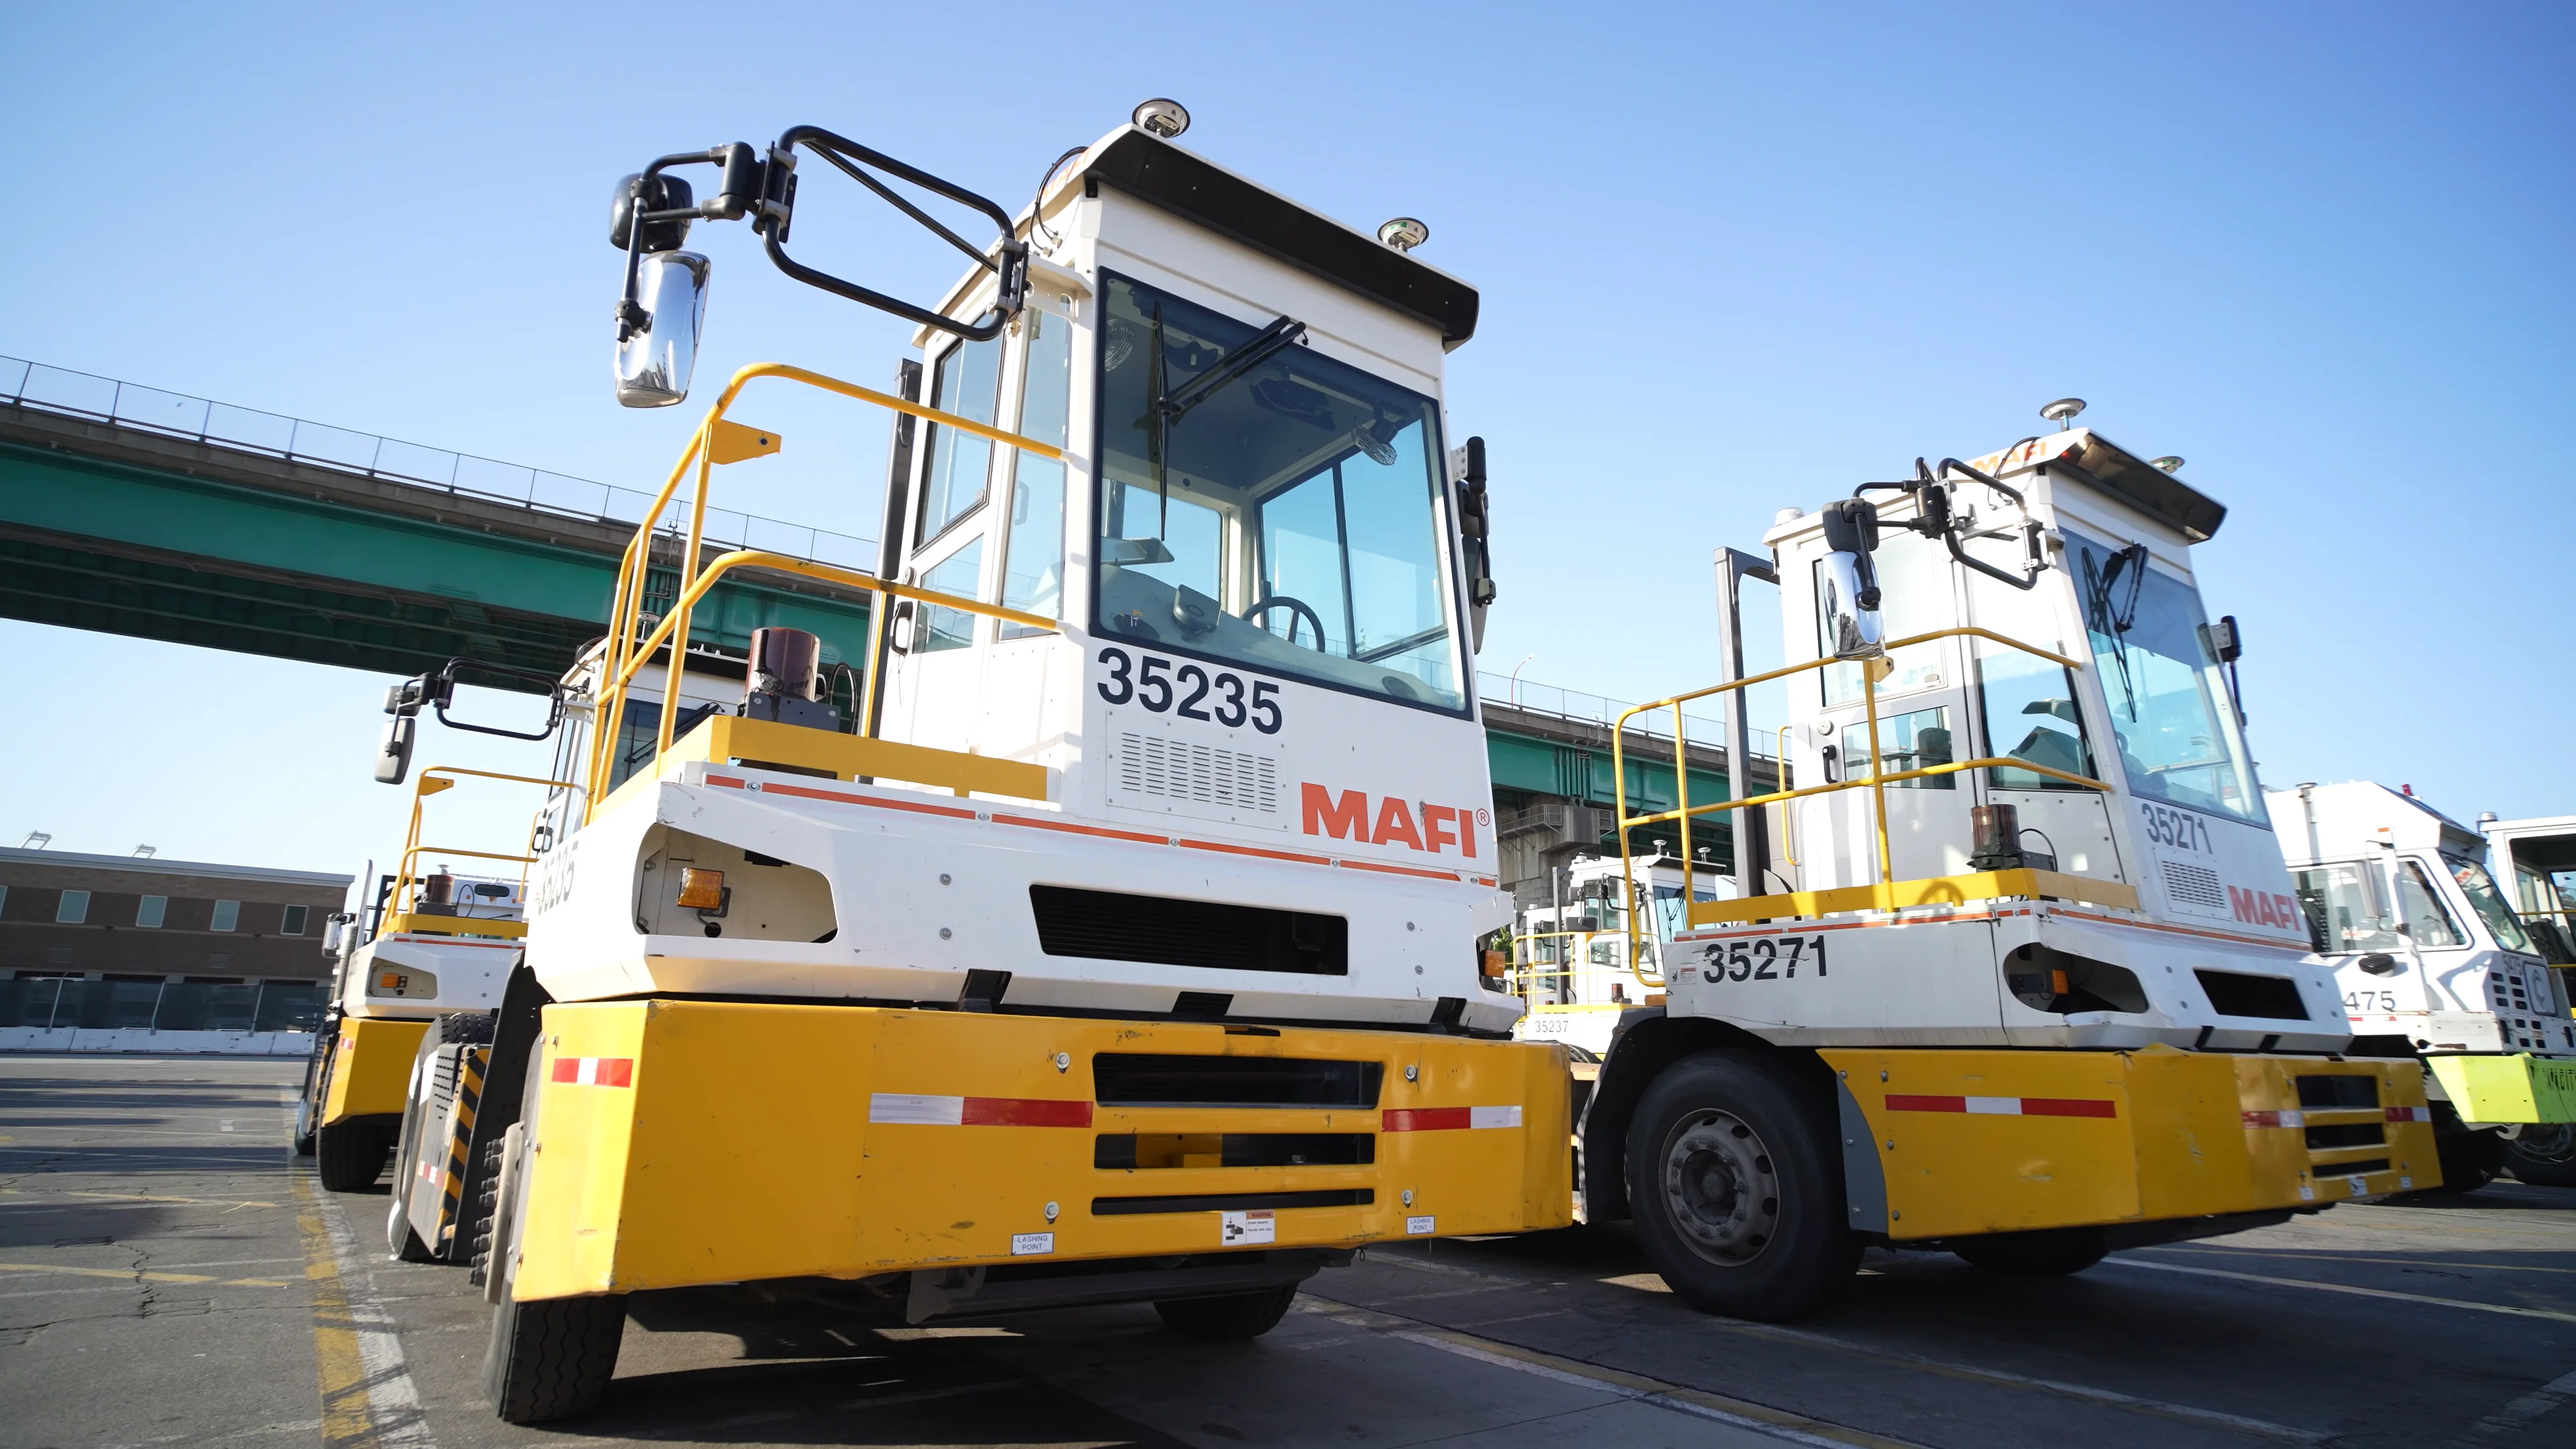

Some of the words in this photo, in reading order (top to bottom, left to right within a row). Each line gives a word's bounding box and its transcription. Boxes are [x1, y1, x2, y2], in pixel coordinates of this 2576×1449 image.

[1973, 442, 2047, 473] MAFI
[1097, 648, 1283, 734] 35235
[2142, 803, 2213, 854] 35271
[2227, 885, 2301, 931] MAFI
[1704, 935, 1827, 983] 35271
[1535, 1020, 1568, 1032] 35237
[1018, 1235, 1048, 1243] LASHING
